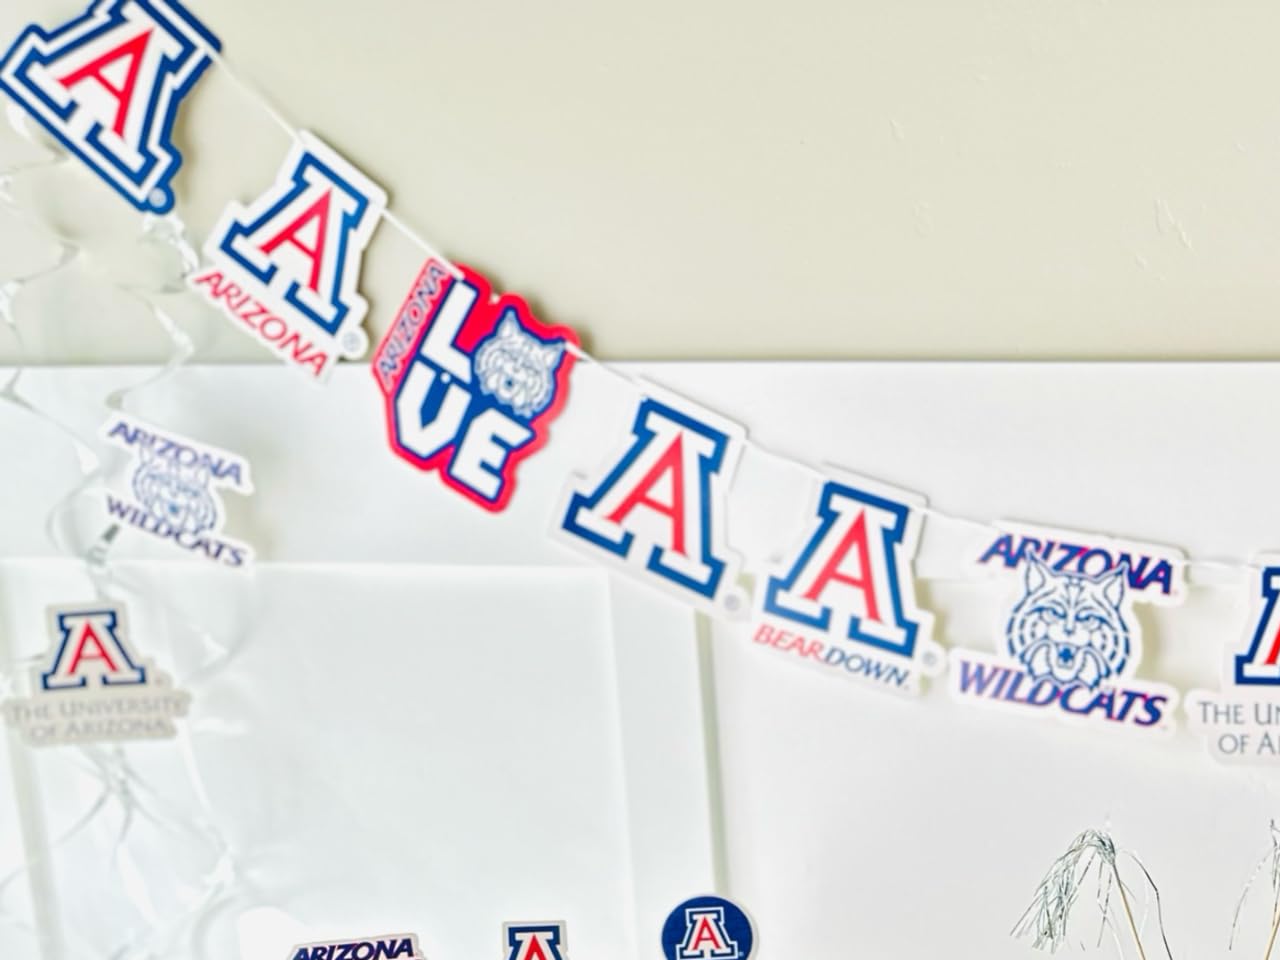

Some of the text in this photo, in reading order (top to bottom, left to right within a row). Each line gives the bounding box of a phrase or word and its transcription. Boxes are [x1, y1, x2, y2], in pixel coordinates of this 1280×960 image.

[4, 0, 206, 206] A
[220, 151, 369, 337] A
[196, 270, 330, 377] ARIZONA
[378, 263, 446, 380] ARIZONA
[108, 421, 243, 485] ARIZONA
[106, 496, 248, 567] WILDCATS
[562, 397, 730, 600] A
[762, 481, 919, 658] A
[977, 534, 1174, 595] ARIZONA
[42, 610, 147, 691] A
[960, 660, 1168, 727] WILDCATS
[1198, 701, 1251, 726] THE
[1217, 733, 1250, 756] OF
